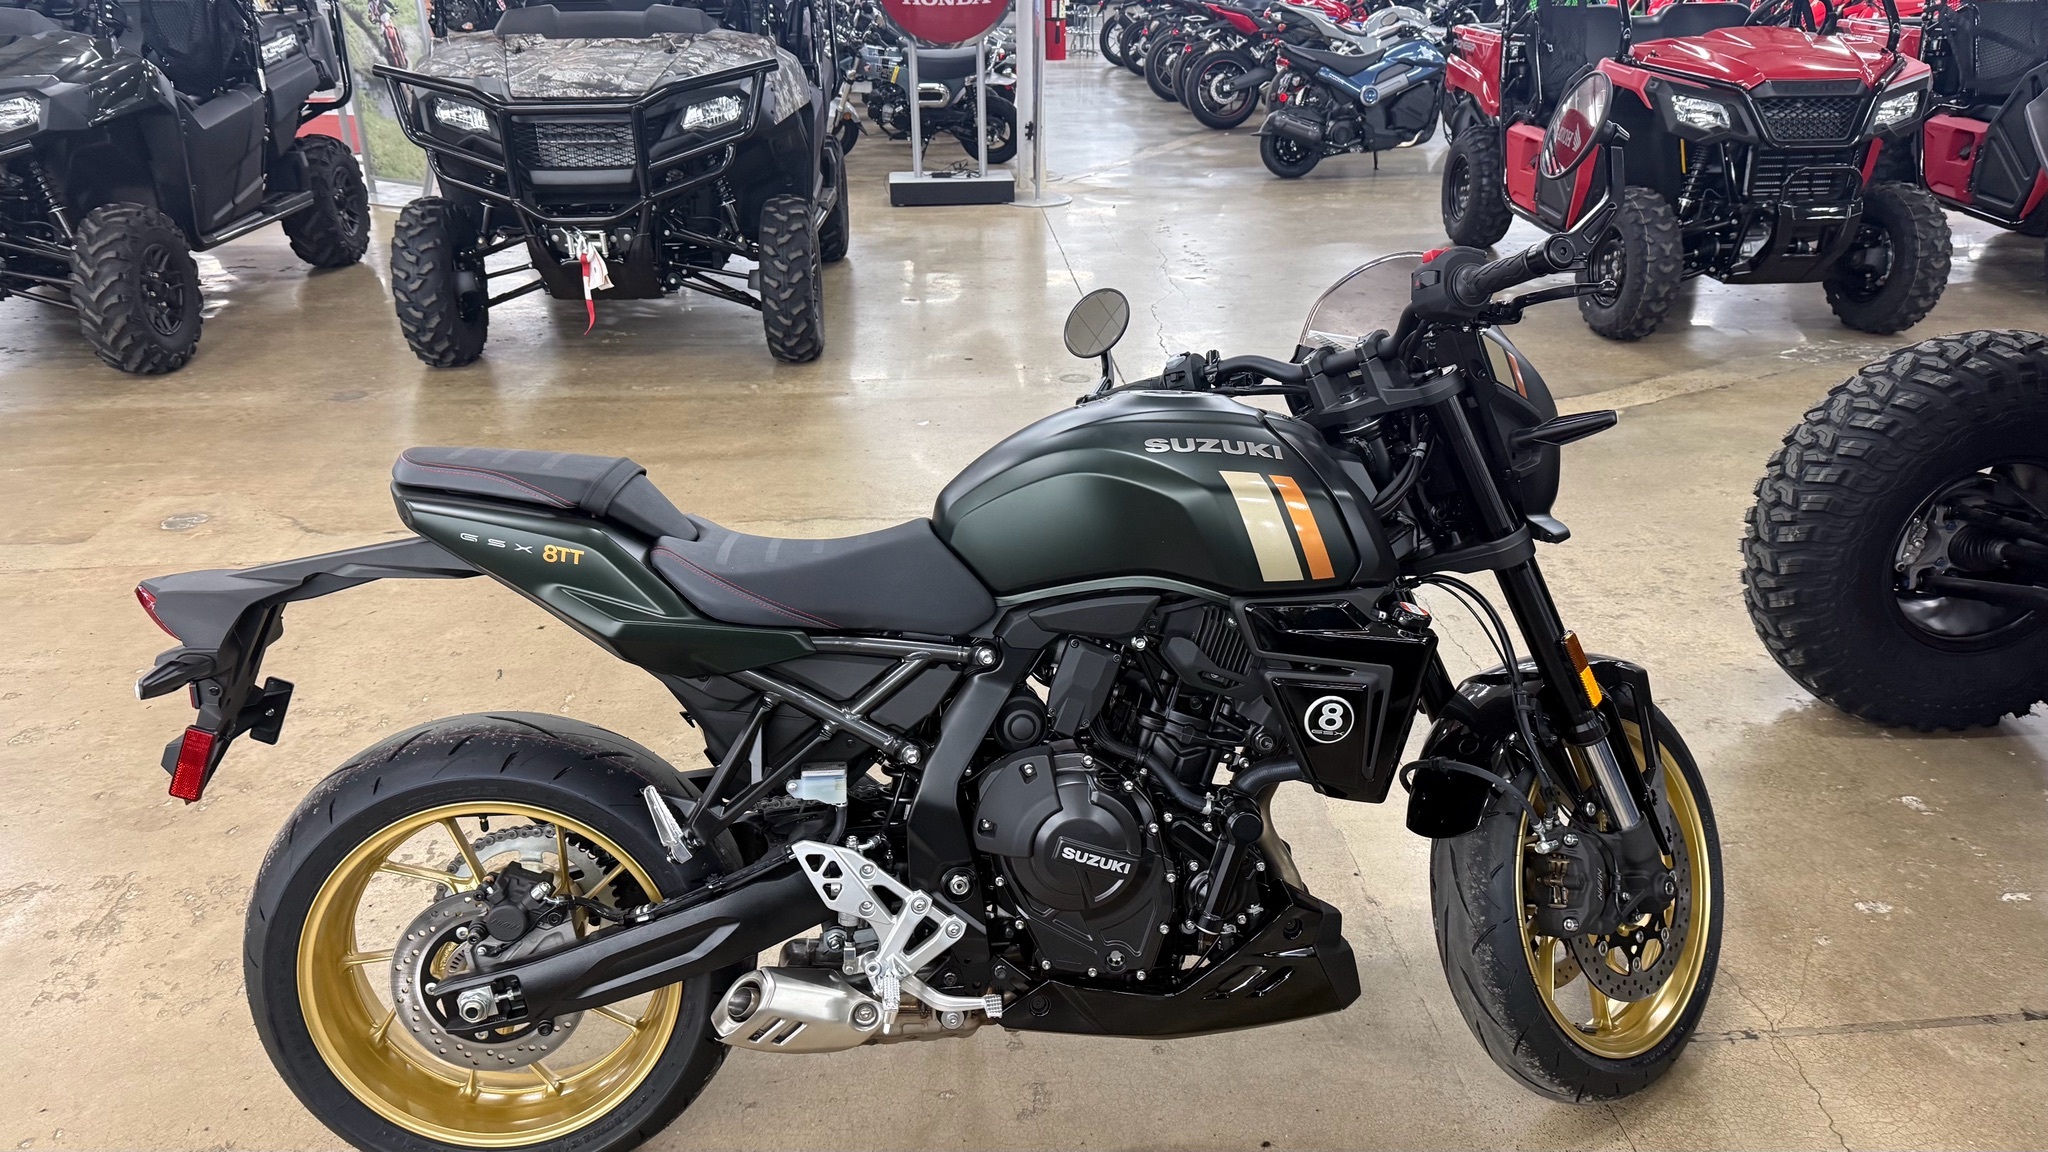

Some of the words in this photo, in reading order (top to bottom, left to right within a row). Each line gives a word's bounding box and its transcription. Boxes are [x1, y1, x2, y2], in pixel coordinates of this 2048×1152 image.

[1144, 437, 1284, 460] SUZUKI
[542, 544, 585, 565] 8TT
[1318, 702, 1344, 731] 8
[1061, 846, 1131, 875] SUZUKI
